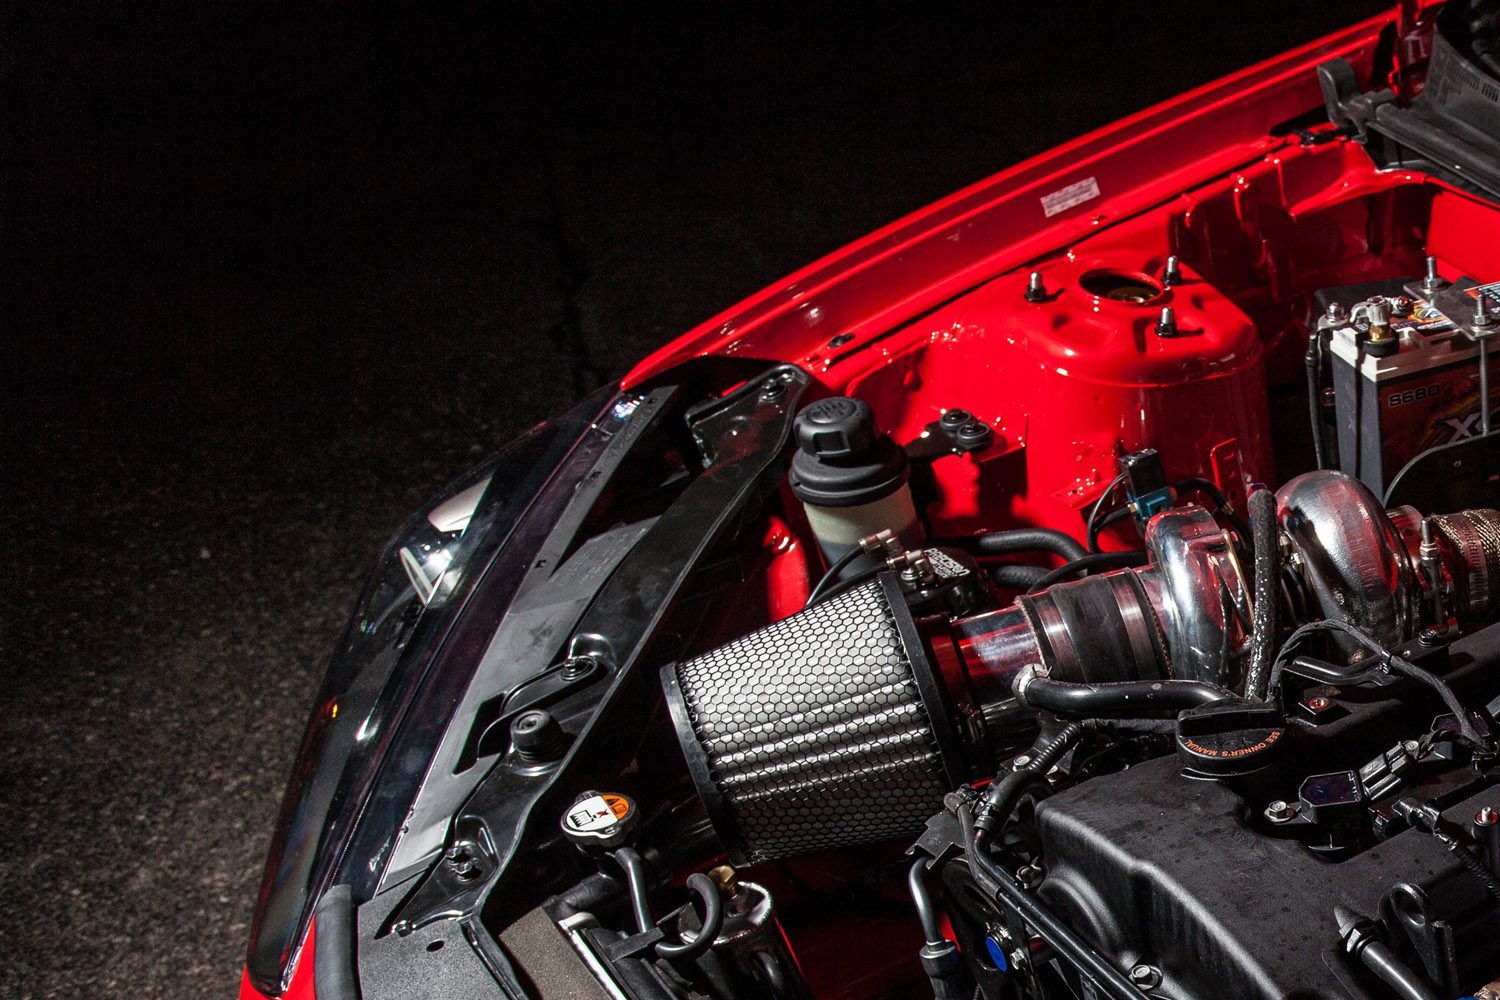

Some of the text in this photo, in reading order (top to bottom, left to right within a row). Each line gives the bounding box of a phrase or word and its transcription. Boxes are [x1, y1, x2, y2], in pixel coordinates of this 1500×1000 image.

[1388, 384, 1440, 408] S680
[1184, 730, 1280, 757] SEE OWNER'S MANUAL
